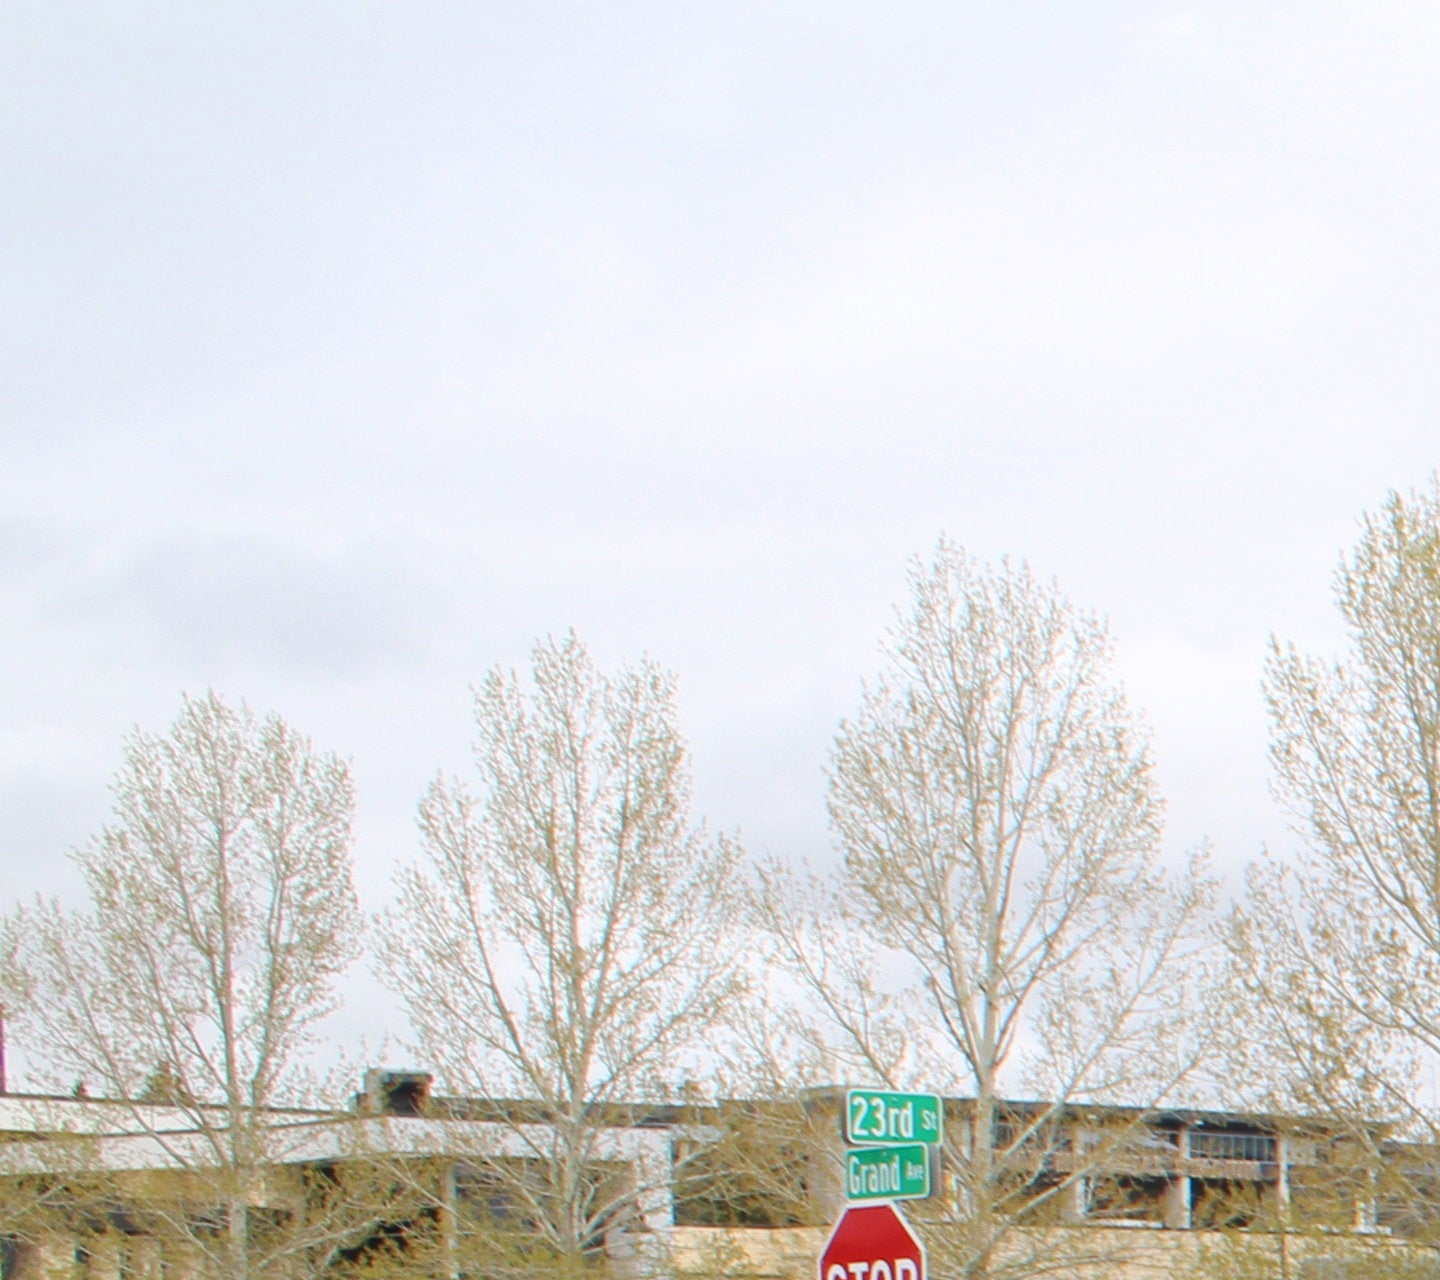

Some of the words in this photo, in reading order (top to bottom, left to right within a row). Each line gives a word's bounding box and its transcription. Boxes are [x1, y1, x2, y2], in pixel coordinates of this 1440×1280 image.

[850, 1096, 914, 1138] 23rd
[922, 1109, 938, 1132] St
[848, 1152, 901, 1196] Grand
[905, 1160, 925, 1181] Ave
